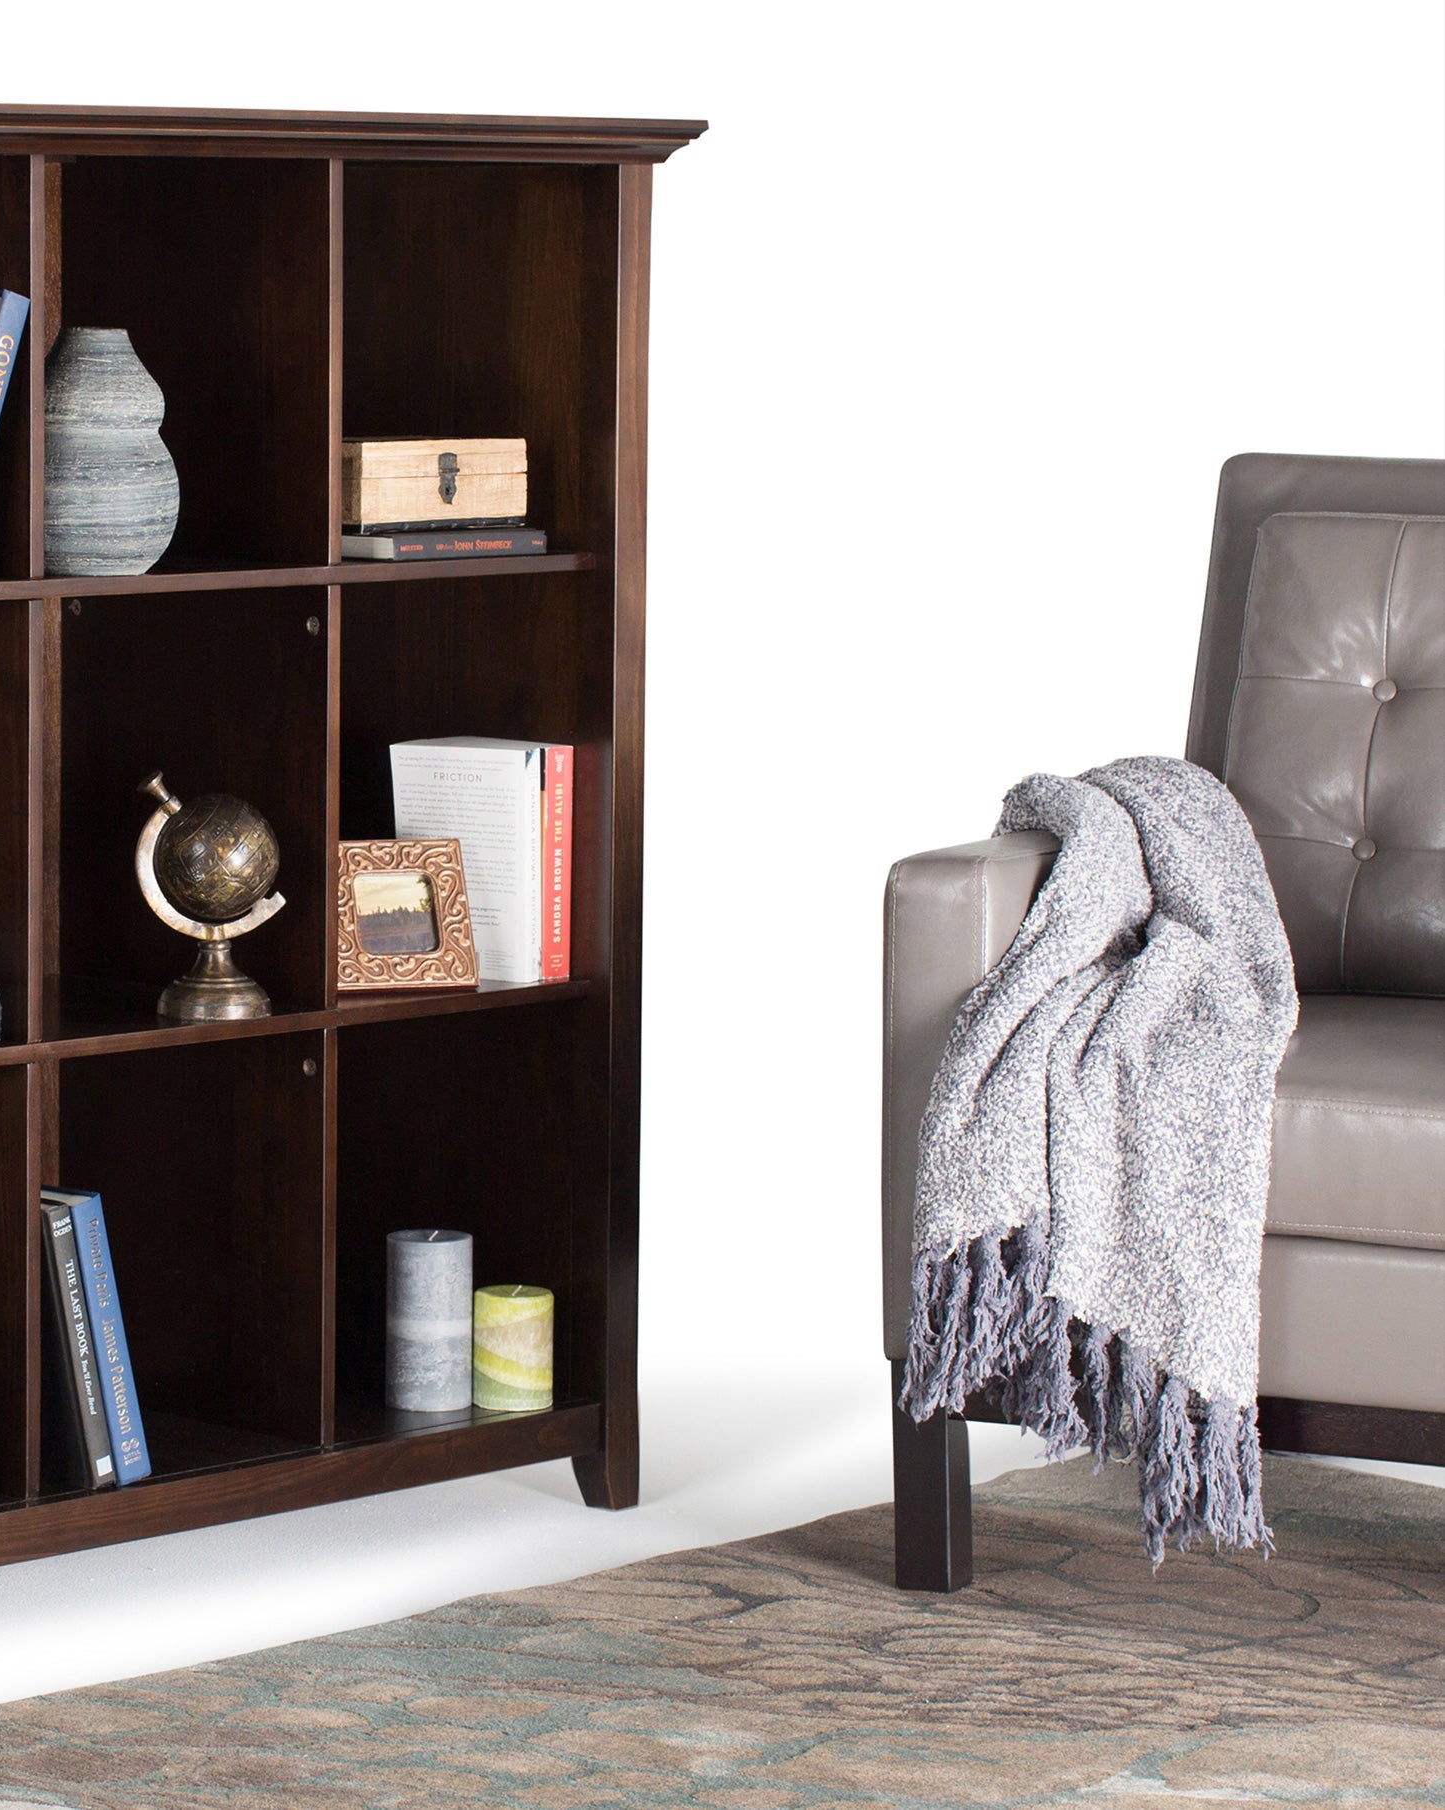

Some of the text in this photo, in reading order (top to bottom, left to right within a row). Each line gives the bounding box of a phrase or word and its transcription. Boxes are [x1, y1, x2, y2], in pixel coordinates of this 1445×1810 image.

[454, 540, 474, 552] JOHN
[433, 771, 483, 783] FRICTION
[555, 783, 563, 814] ALIBI
[554, 819, 563, 843] THE
[553, 848, 563, 891] BROWN
[553, 895, 562, 943] SANDRA
[65, 1258, 77, 1288] THE
[69, 1288, 84, 1320] LAST
[75, 1322, 89, 1358] BOOK
[87, 1217, 132, 1435] Private Paris James Patterson
